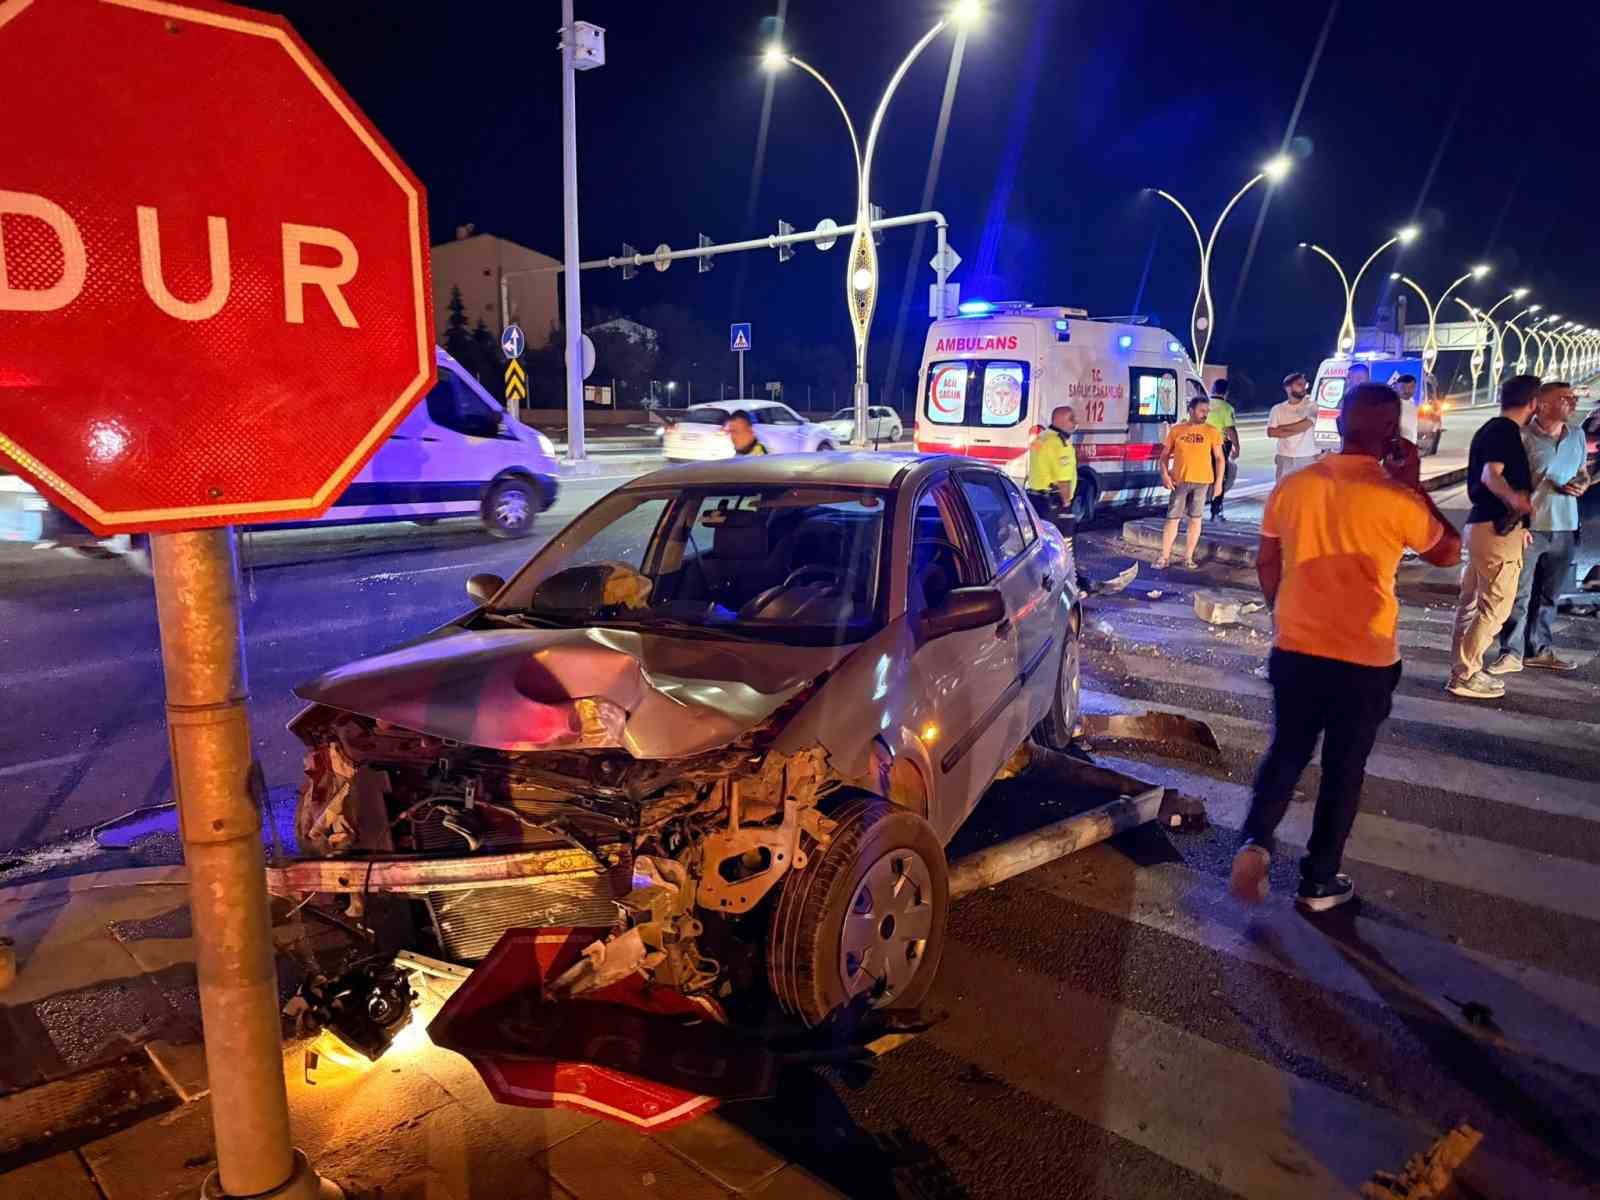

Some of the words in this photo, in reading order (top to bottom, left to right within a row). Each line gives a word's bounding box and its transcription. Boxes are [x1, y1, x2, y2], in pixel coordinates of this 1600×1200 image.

[0, 190, 360, 328] DUR
[936, 336, 1018, 352] AMBULANS
[1086, 401, 1104, 422] 112
